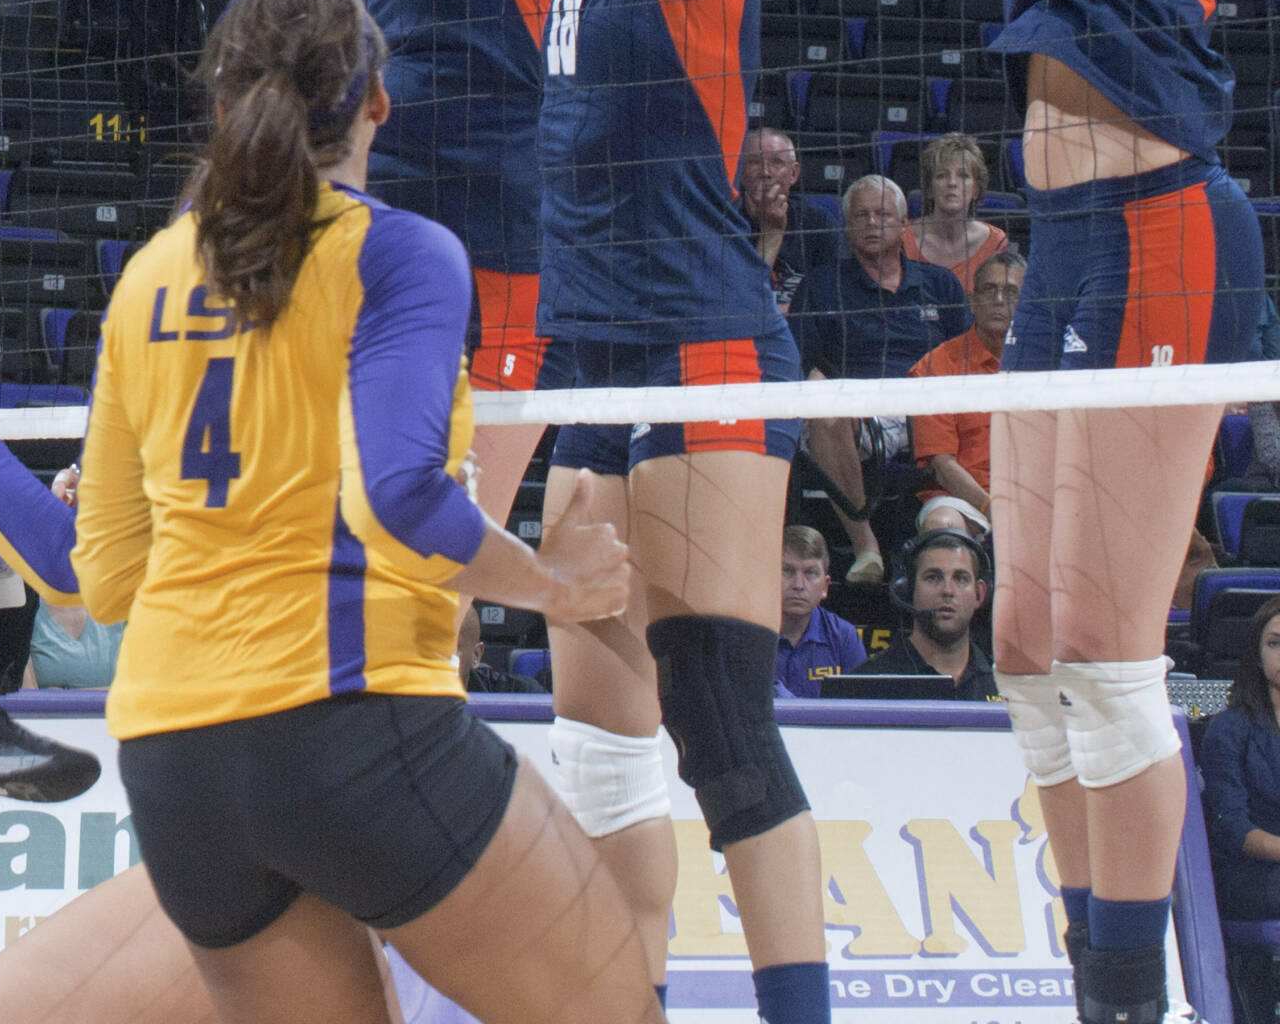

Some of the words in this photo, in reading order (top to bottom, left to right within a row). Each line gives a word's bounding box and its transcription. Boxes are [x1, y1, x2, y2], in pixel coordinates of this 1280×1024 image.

[149, 284, 258, 342] LS
[1151, 344, 1174, 367] 10
[180, 357, 241, 508] 4
[808, 666, 842, 680] LSU
[887, 973, 956, 1003] Dry
